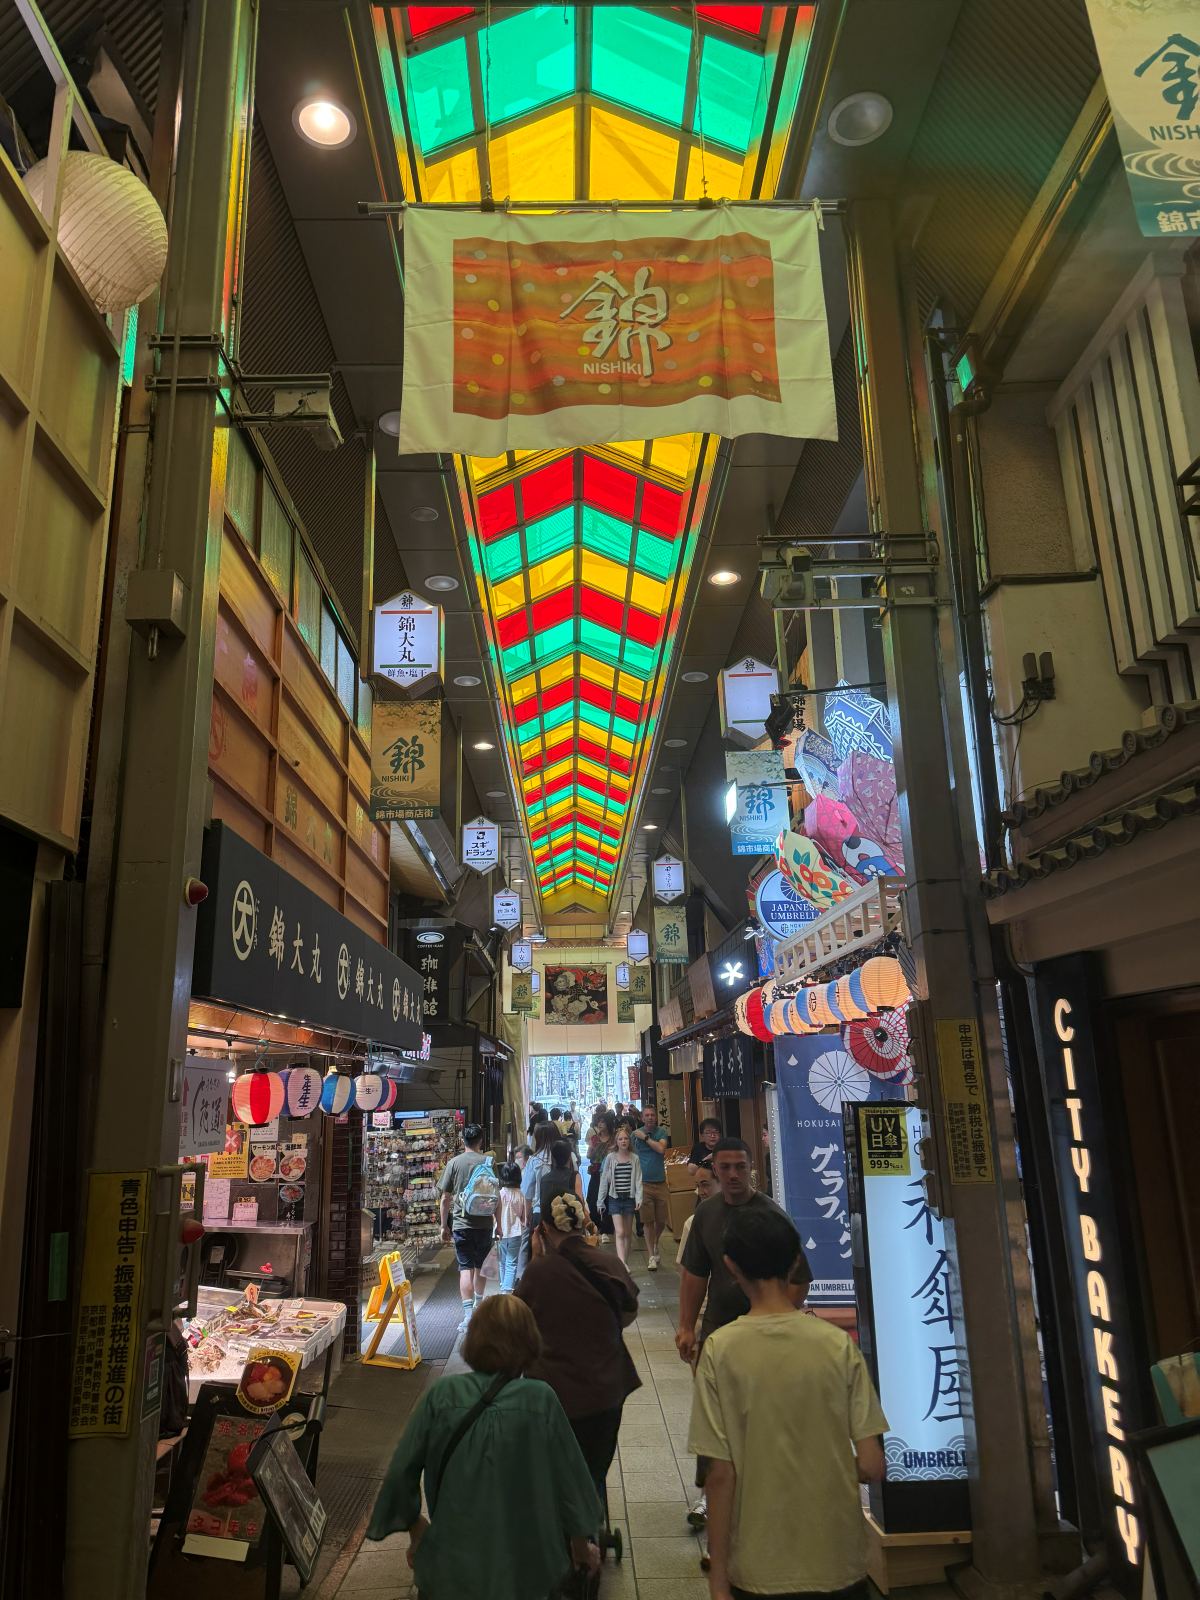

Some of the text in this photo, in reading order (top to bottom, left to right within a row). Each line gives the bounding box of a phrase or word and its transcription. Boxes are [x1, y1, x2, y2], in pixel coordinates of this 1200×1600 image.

[1150, 125, 1200, 141] NISH
[560, 266, 673, 378] 錦
[583, 362, 642, 375] NISHIKI
[398, 616, 416, 662] 錦大丸
[383, 735, 425, 784] 錦
[375, 808, 434, 819] 錦市場商店街
[739, 780, 776, 823] 錦
[770, 912, 821, 920] UMBRELL
[771, 903, 818, 912] JAPANES
[268, 905, 322, 984] 錦大丸
[355, 957, 384, 1010] 錦大丸
[421, 954, 439, 1016] 珈琲館
[958, 1023, 979, 1096] 申告は青色で
[797, 1119, 841, 1128] HOKUSAI
[870, 1117, 896, 1132] UV
[871, 1133, 898, 1148] 日傘
[968, 1103, 987, 1178] 納税は振替で
[103, 1179, 141, 1425] 青色申告・振替納税推進の街
[1054, 998, 1139, 1565] CITY BAKERY
